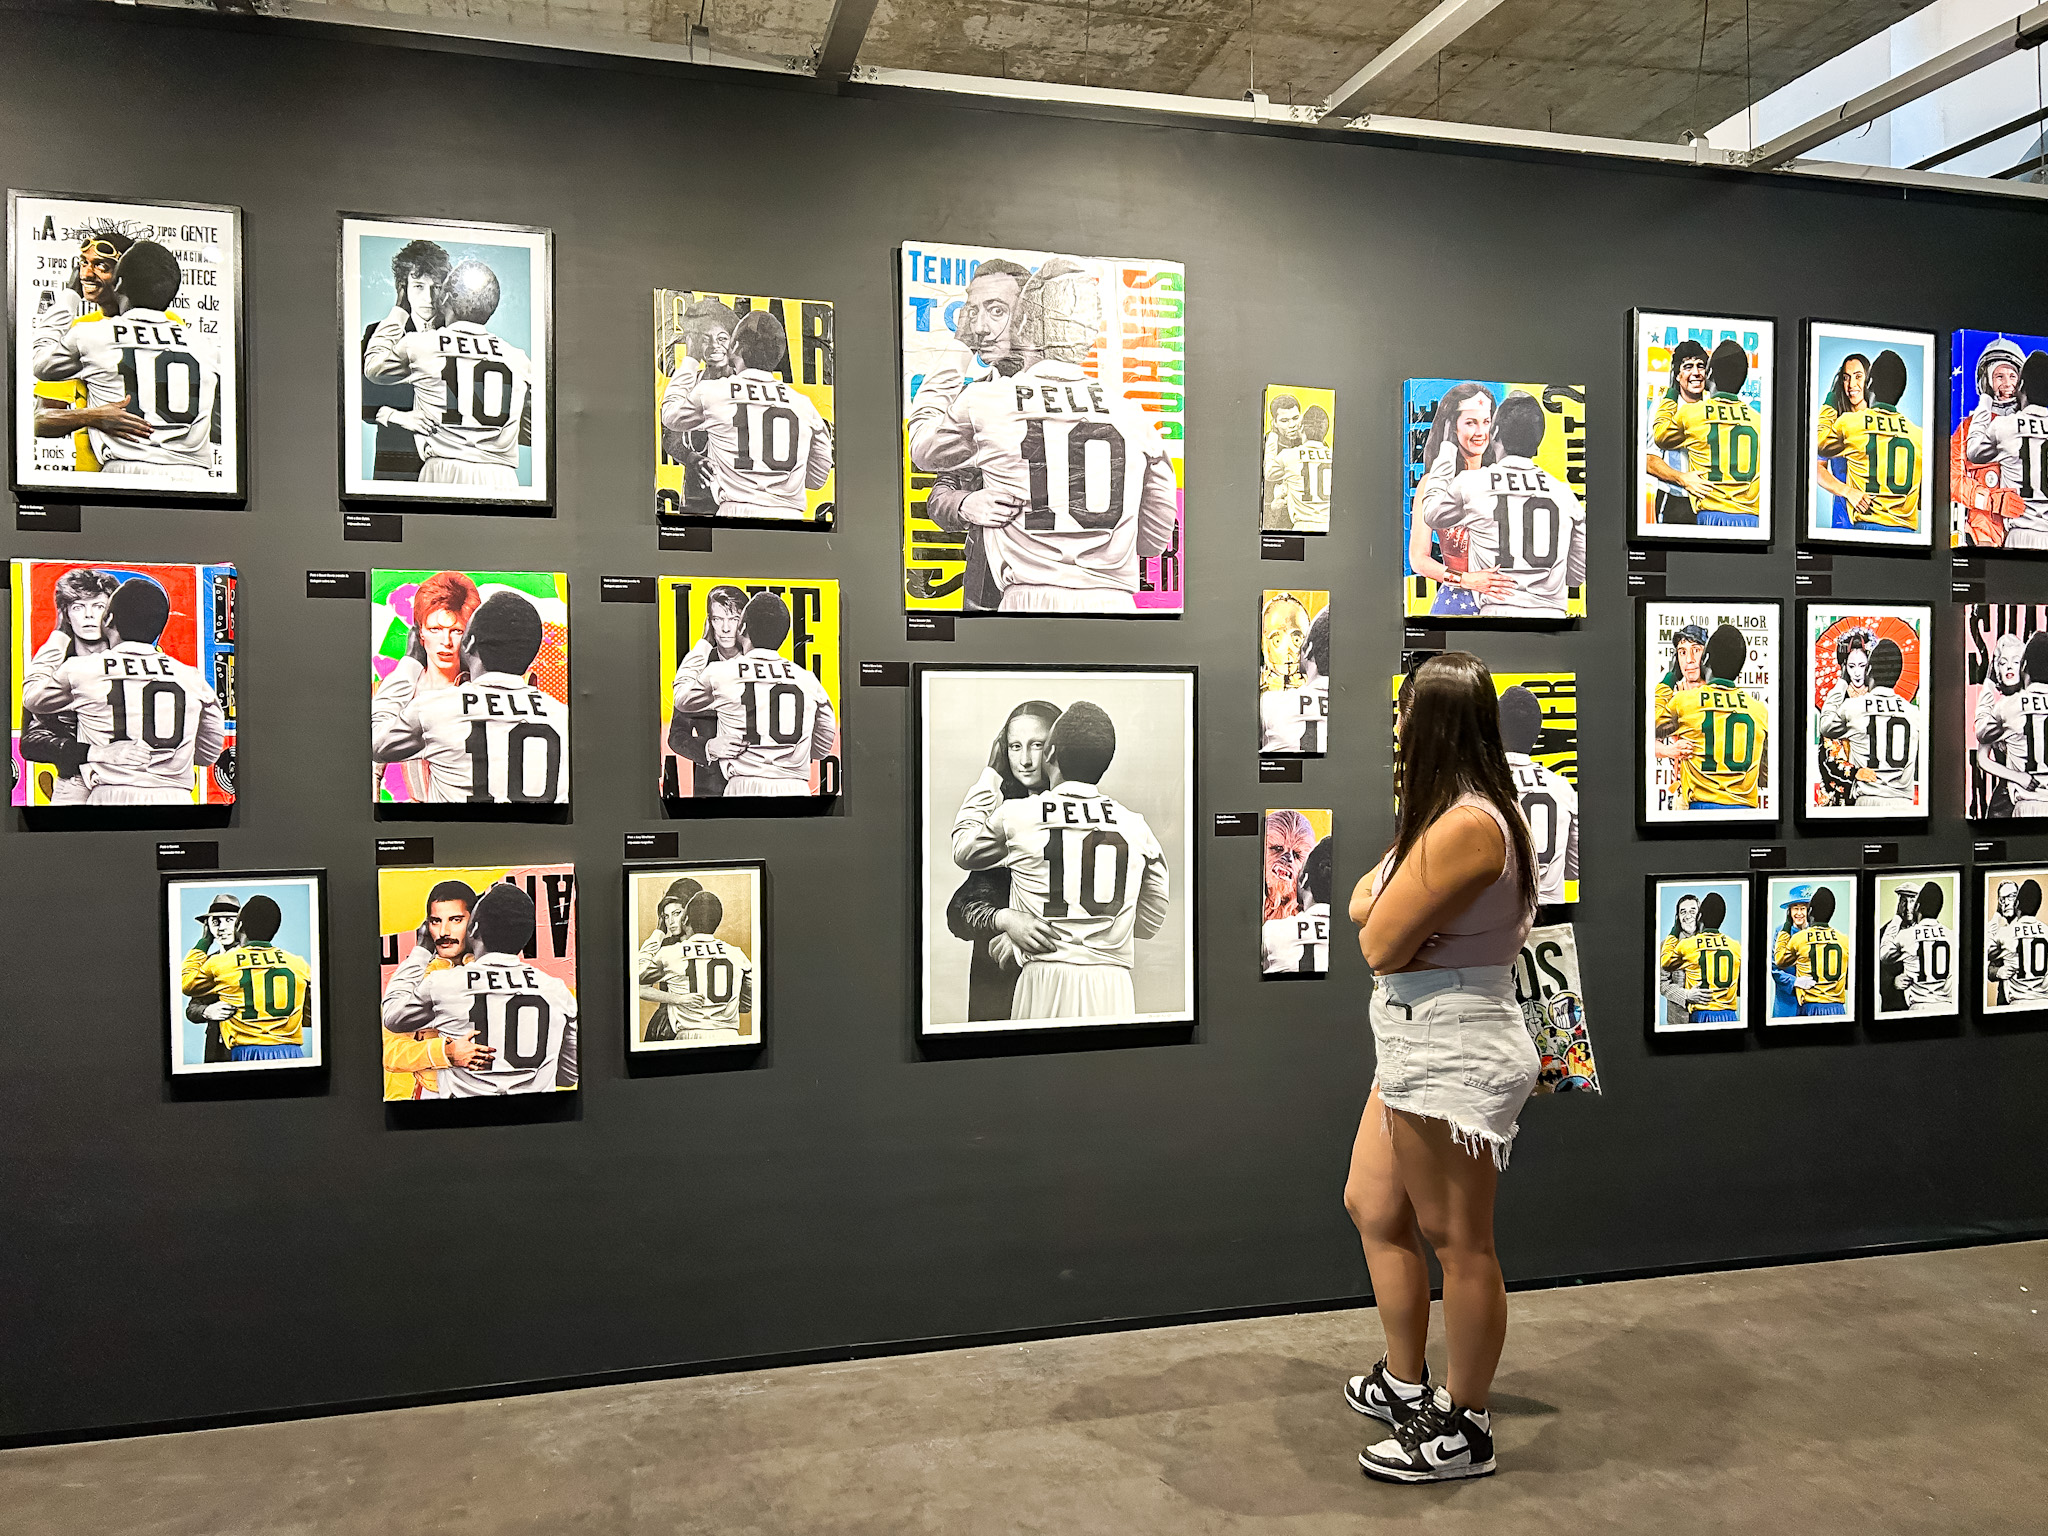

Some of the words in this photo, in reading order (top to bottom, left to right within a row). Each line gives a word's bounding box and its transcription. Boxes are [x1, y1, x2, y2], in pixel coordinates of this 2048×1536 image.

[37, 256, 45, 270] 3
[47, 257, 68, 269] TIPOS
[180, 225, 219, 243] GENTE
[117, 348, 201, 425] 10
[440, 356, 513, 427] 10
[732, 403, 799, 472] 10
[1706, 423, 1760, 483] 10
[1864, 433, 1915, 495] 10
[1020, 418, 1126, 531] 10
[1493, 494, 1560, 570] 10
[1737, 671, 1769, 684] FILME
[106, 679, 186, 750] 10
[740, 682, 805, 746] 10
[1701, 710, 1756, 772] 10
[1866, 715, 1911, 769] 10
[465, 720, 561, 803] 10
[1042, 828, 1130, 918] 10
[685, 958, 734, 1004] 10
[1699, 949, 1734, 990] 10
[1809, 943, 1843, 982] 10
[1917, 940, 1950, 983] 10
[2016, 937, 2048, 980] 10
[239, 967, 296, 1021] 10
[469, 993, 550, 1071] 10
